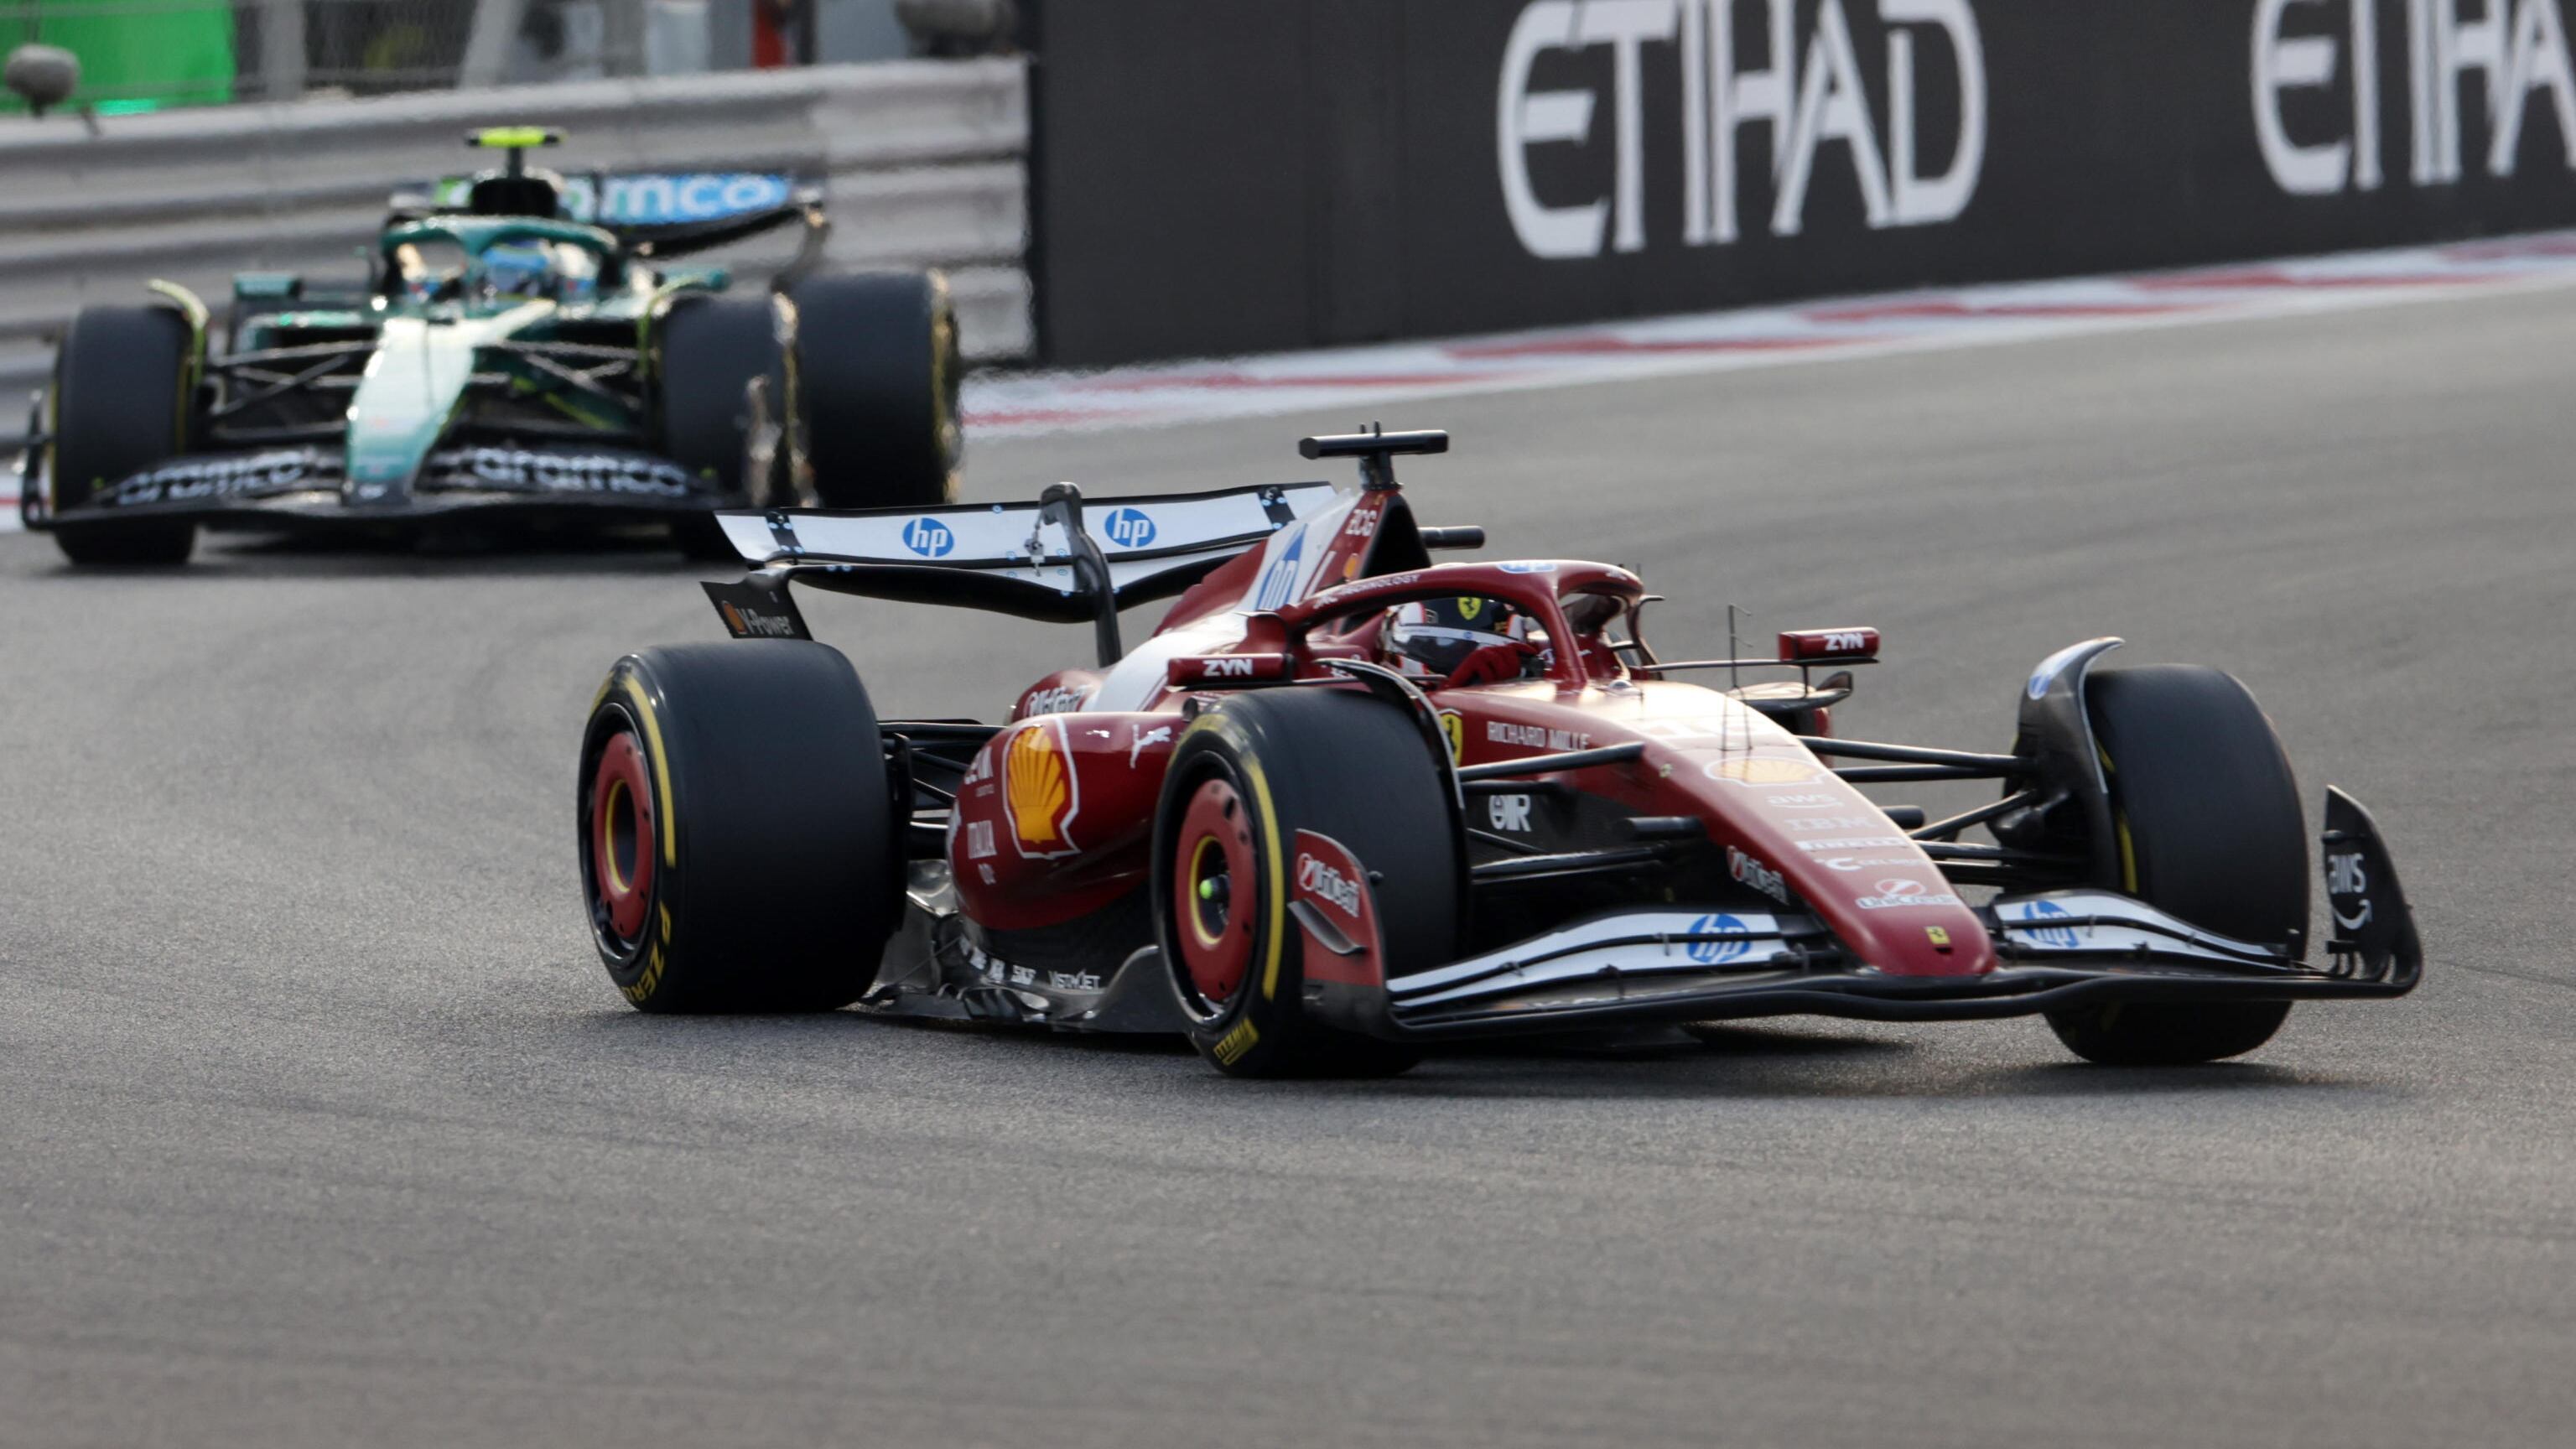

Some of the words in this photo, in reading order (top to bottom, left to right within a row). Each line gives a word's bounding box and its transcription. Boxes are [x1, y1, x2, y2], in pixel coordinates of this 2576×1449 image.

[2251, 0, 2576, 194] ETIHA
[1498, 0, 1987, 258] ETIHAD
[474, 447, 688, 496] aramco
[910, 517, 948, 558] hp
[1113, 508, 1150, 548] hp
[1824, 632, 1864, 651] ZYN
[1202, 659, 1253, 676] ZYN
[1487, 721, 1545, 747] RICHARD
[1692, 912, 1743, 962] hp
